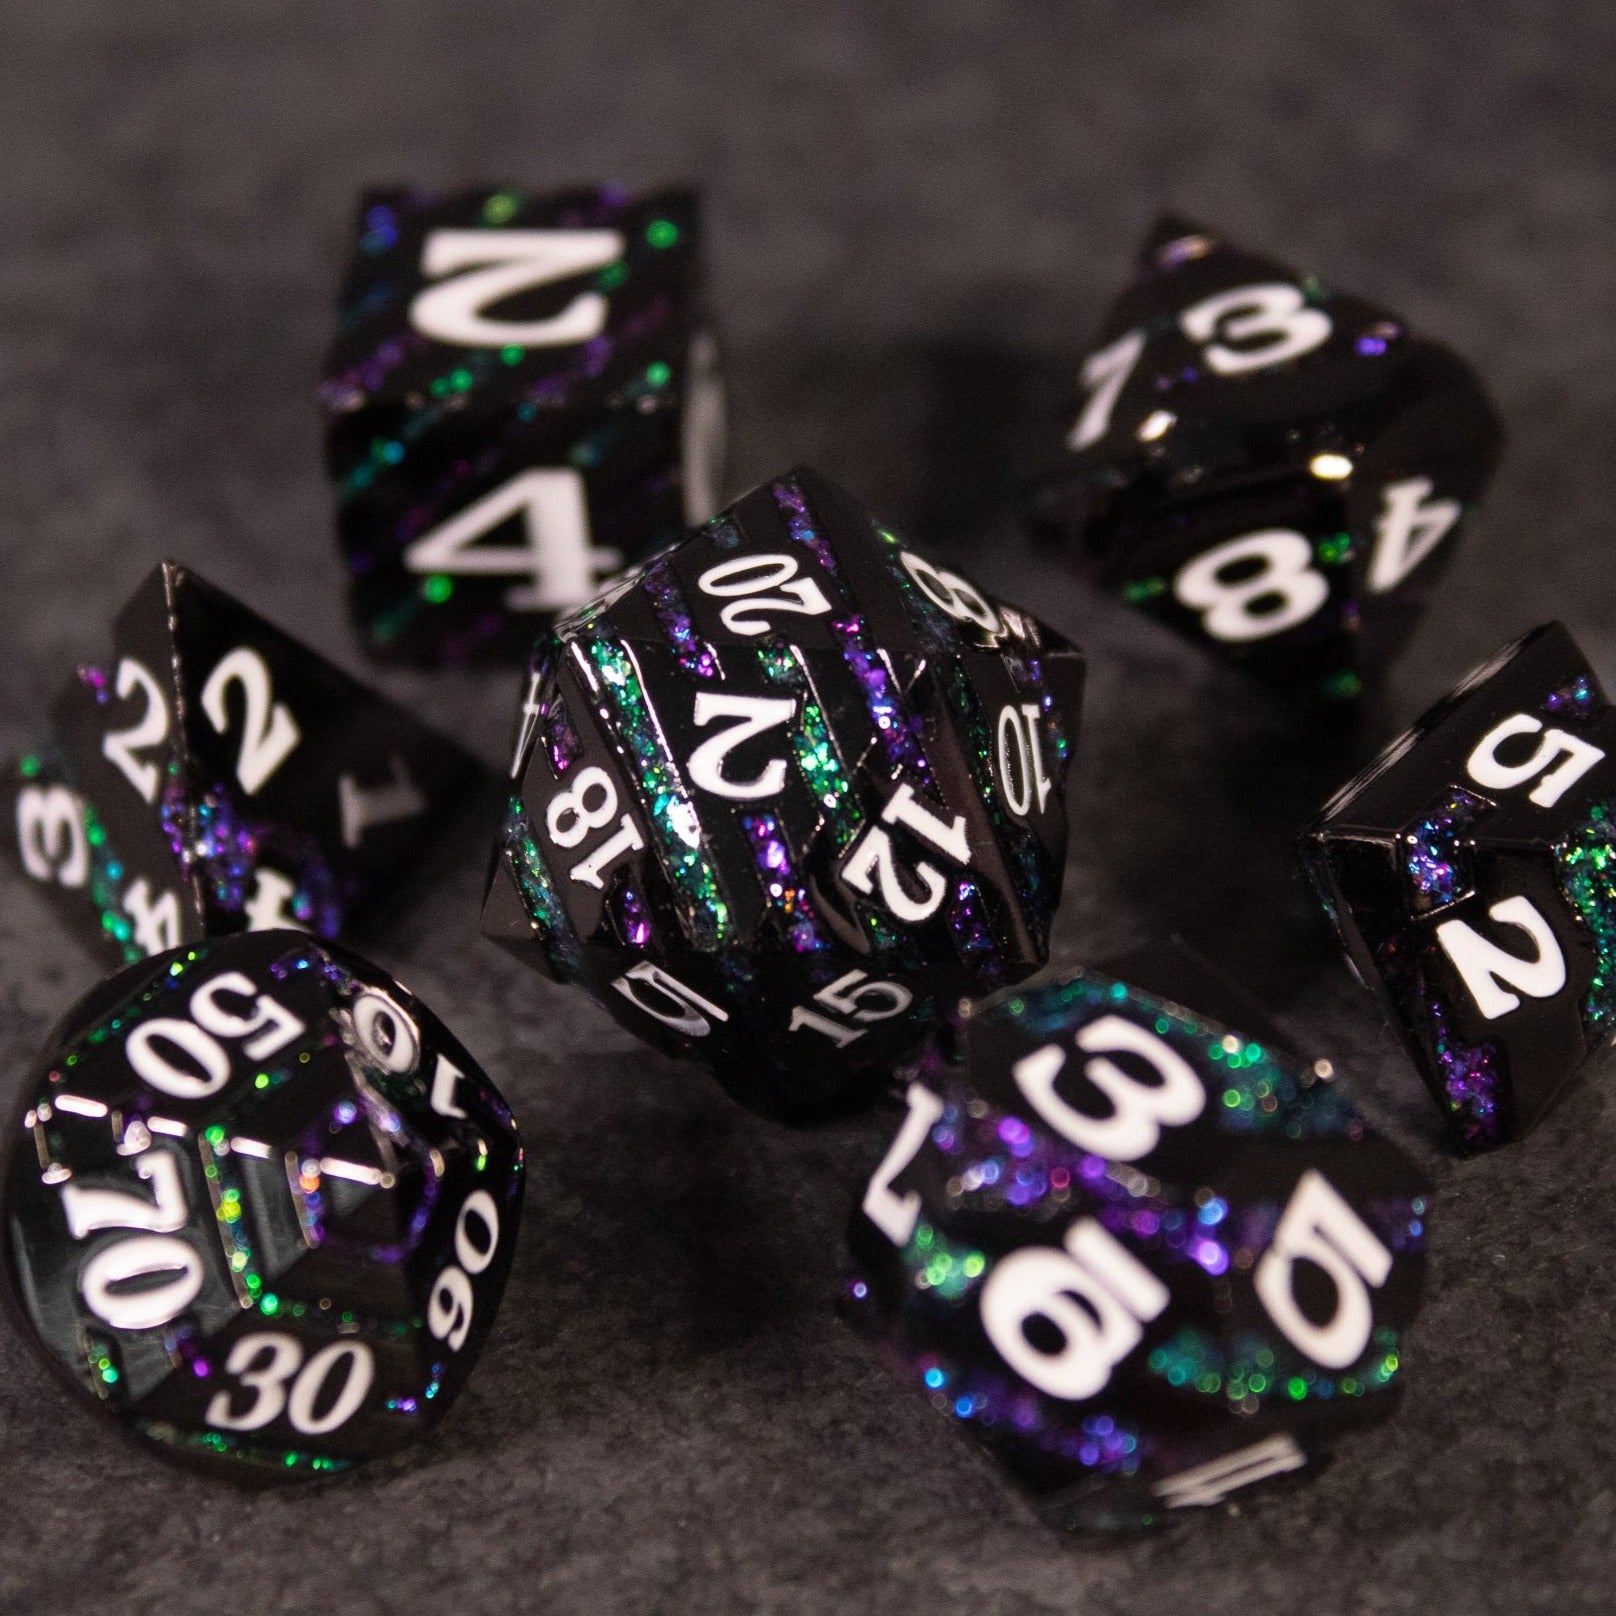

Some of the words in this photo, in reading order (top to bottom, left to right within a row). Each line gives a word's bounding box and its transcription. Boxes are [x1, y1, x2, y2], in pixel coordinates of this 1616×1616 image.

[410, 229, 624, 348] 2
[1183, 284, 1331, 373] 3
[406, 467, 623, 610] 4
[900, 551, 1000, 633] 8
[1177, 531, 1327, 639] 8
[1369, 478, 1460, 591] 4
[697, 554, 832, 636] 20
[103, 658, 169, 803] 2
[201, 649, 297, 793] 2
[685, 691, 797, 799] 2
[997, 704, 1052, 816] 10
[1466, 713, 1606, 808] 5
[16, 787, 88, 887] 3
[546, 766, 645, 890] 18
[841, 782, 972, 922] 12
[788, 969, 913, 1048] 15
[1436, 895, 1566, 1020] 2
[126, 972, 304, 1099] 50
[1014, 1015, 1205, 1161] 3
[863, 1084, 943, 1245] 7
[63, 1152, 202, 1330] 70
[429, 1191, 499, 1351] 90
[207, 1334, 372, 1434] 30
